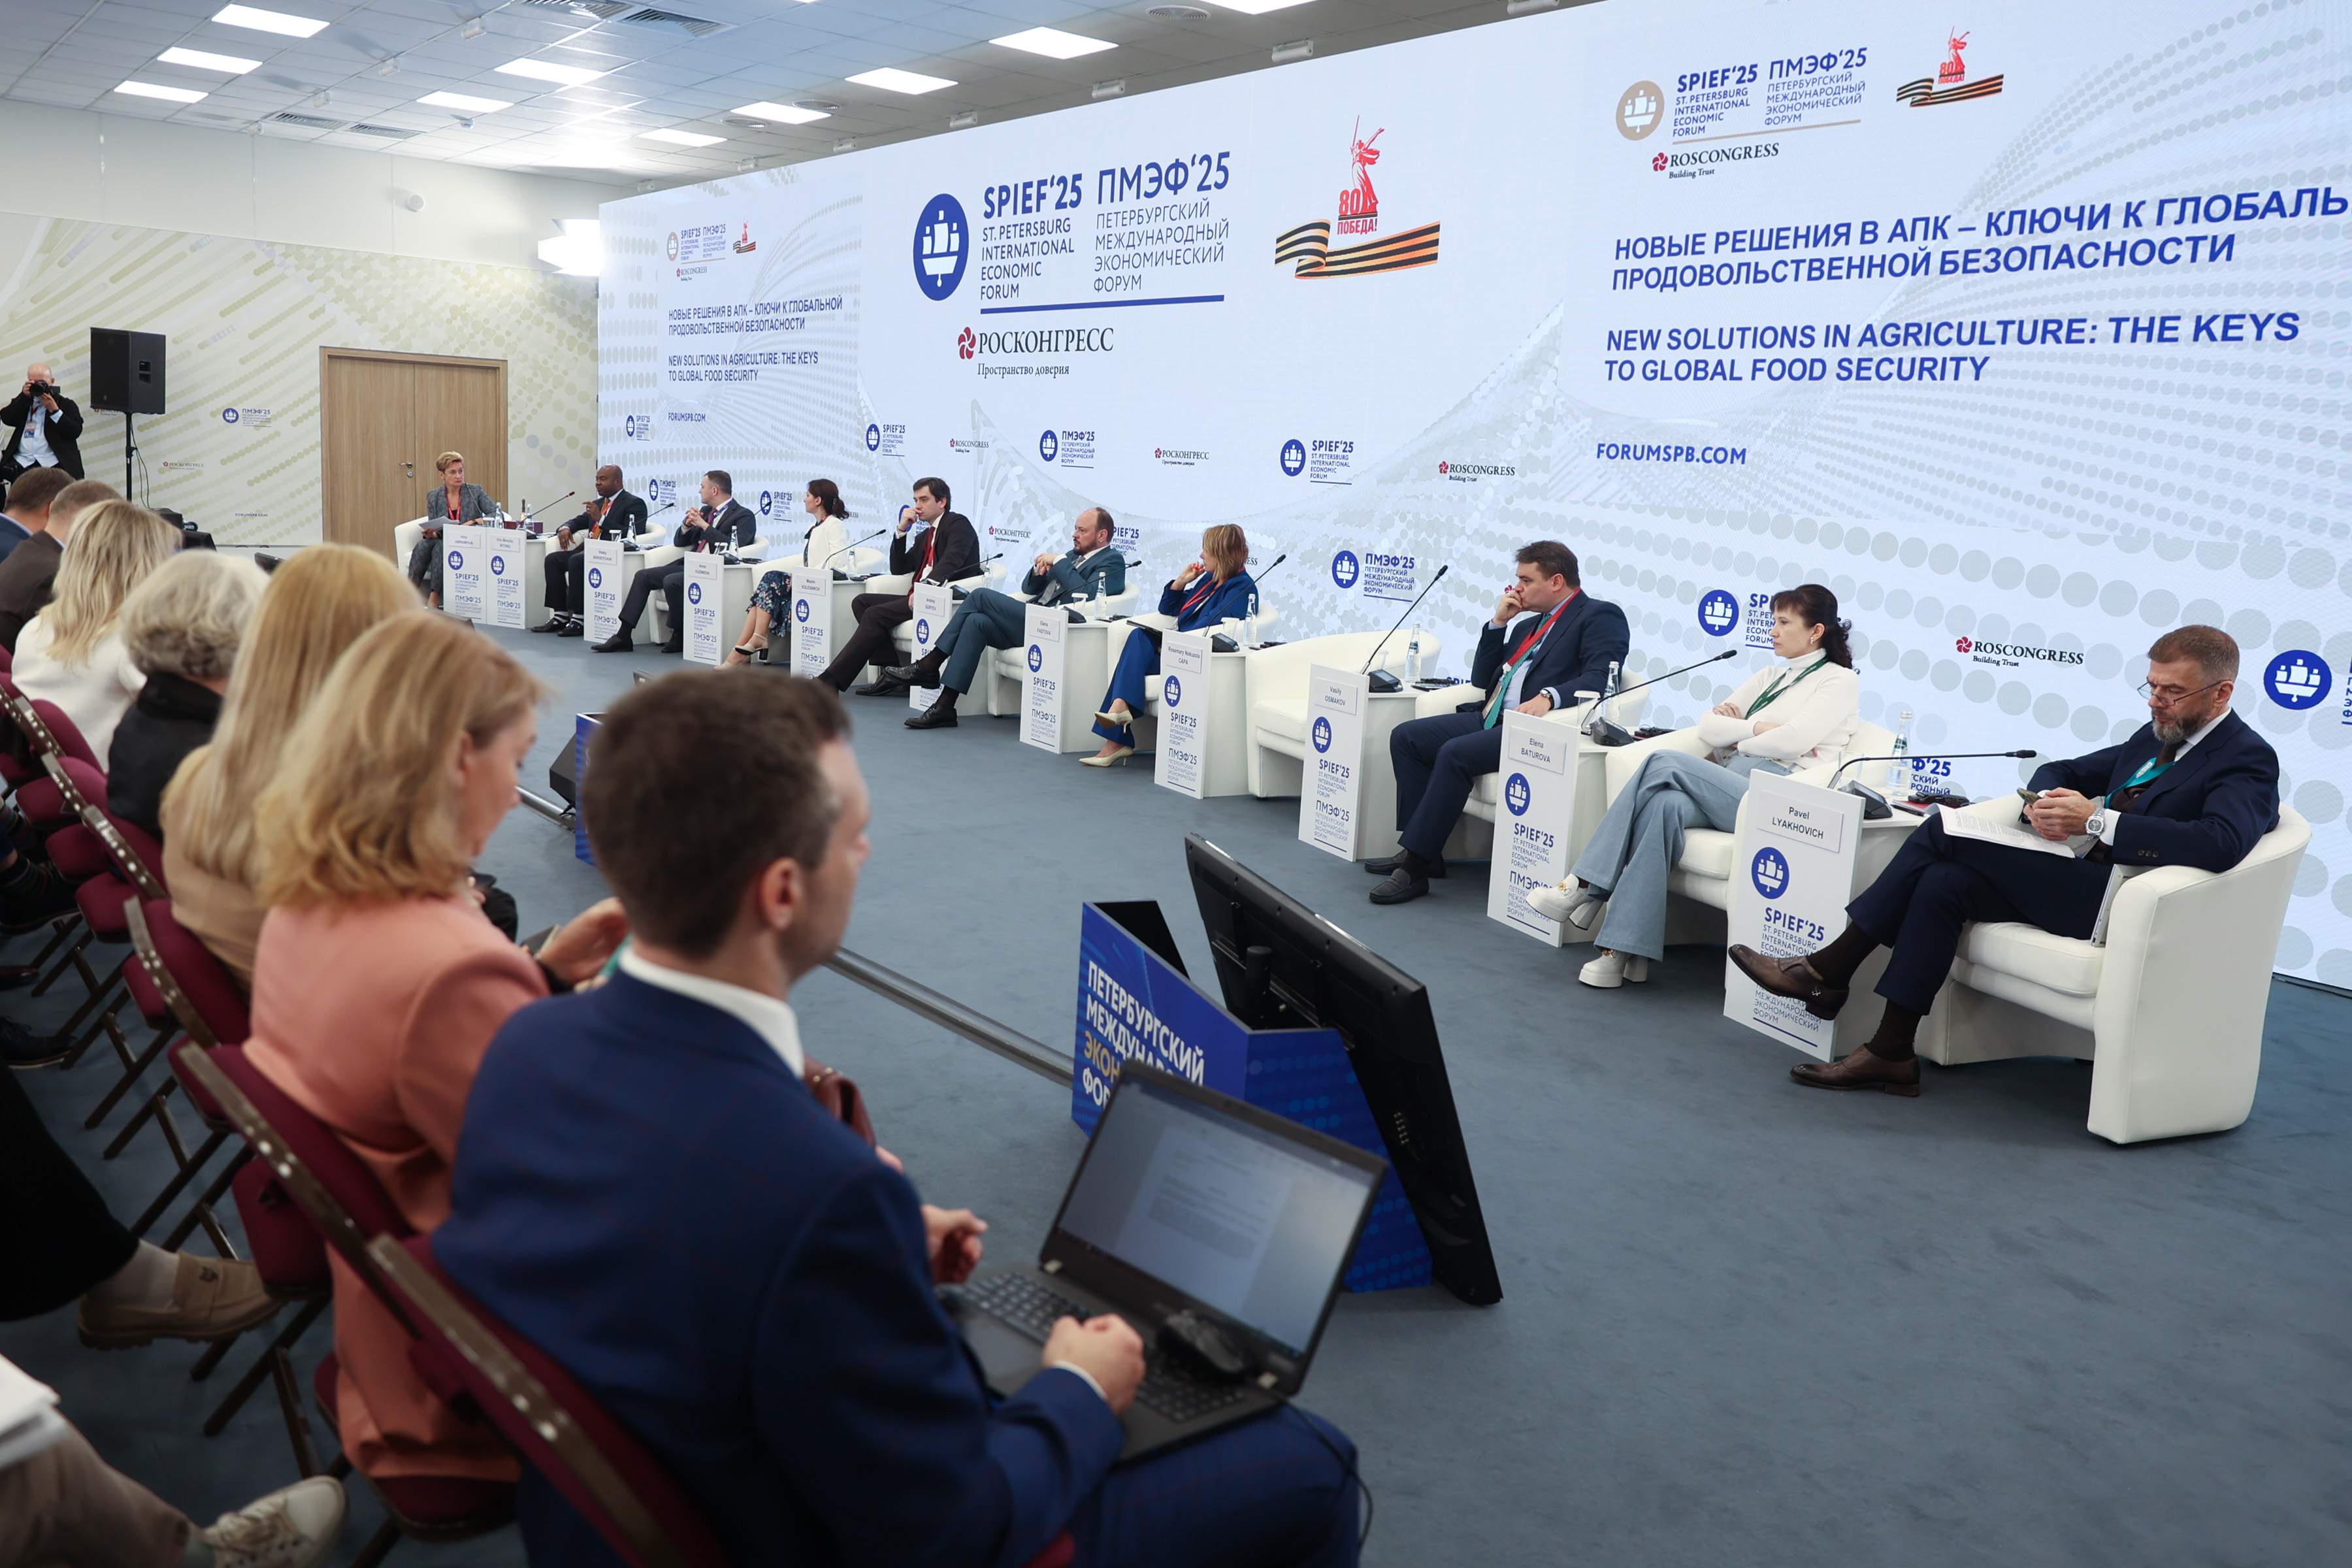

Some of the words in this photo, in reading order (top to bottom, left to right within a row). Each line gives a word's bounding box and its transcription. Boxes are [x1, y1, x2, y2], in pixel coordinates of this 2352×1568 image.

[1769, 47, 1867, 80] ПМЭФ'25
[1677, 63, 1757, 93] SPIEF'25
[1768, 71, 1852, 93] ПЕТЕРБУРГСКИЙ
[1676, 97, 1688, 105] ST.
[1690, 88, 1748, 103] PETERSBURG
[1767, 81, 1865, 104] МЕЖДУНАРОДНЫЙ
[1674, 98, 1750, 116] INTERNATIONAL
[1765, 93, 1861, 115] ЭКОНОМИЧЕСКИЙ
[1674, 112, 1724, 127] ECONOMIC
[1765, 114, 1802, 125] ФОРУМ
[1673, 125, 1705, 137] FORUM
[1670, 142, 1779, 167] ROSCONGRESS
[1098, 151, 1230, 204] ПМЭФ'25
[1669, 170, 1696, 178] Building
[983, 173, 1083, 219] SPIEF'25
[1339, 188, 1360, 216] 80
[1096, 197, 1209, 229] ПЕТЕРБУРГСКИЙ
[983, 227, 996, 242] ST.
[1000, 218, 1071, 240] PETERSBURG
[1337, 218, 1377, 235] ПОБЕДА!
[1614, 233, 1707, 260] НОВЫЕ
[1714, 222, 1852, 253] РЕШЕНИЯ
[1859, 221, 1878, 245] В
[1887, 215, 1952, 243] АПК
[1985, 203, 2112, 237] КЛЮЧИ
[2122, 200, 2146, 228] К
[2156, 186, 2352, 227] ГЛОБАЛЬ
[1096, 218, 1229, 251] МЕЖДУНАРОДНЫЙ
[982, 238, 1074, 261] INTERNATIONAL
[1094, 242, 1224, 272] ЭКОНОМИЧЕСКИЙ
[981, 261, 1041, 280] ECONOMIC
[1612, 246, 1932, 292] ПРОДОВОЛЬСТВЕННОЙ
[1938, 234, 2236, 276] БЕЗОПАСНОСТИ
[1094, 274, 1141, 293] ФОРУМ
[981, 284, 1019, 300] FORUM
[669, 308, 692, 320] НОВЫЕ
[693, 306, 725, 319] РЕШЕНИЯ
[728, 305, 732, 317] В
[734, 304, 747, 317] АПК
[755, 302, 780, 316] КЛЮЧИ
[783, 301, 787, 313] К
[789, 295, 842, 313] ГЛОБАЛЬНОЙ
[669, 318, 743, 336] ПРОДОВОЛЬСТВЕННОЙ
[745, 318, 805, 332] БЕЗОПАСНОСТИ
[1607, 329, 1661, 351] NEW
[1667, 325, 1816, 350] SOLUTIONS
[1823, 325, 1851, 348] IN
[1857, 318, 2097, 348] AGRICULTURE:
[2108, 316, 2181, 344] THE
[2192, 312, 2300, 342] KEYS
[979, 328, 1114, 353] РОСКОНГРЕСС
[669, 355, 682, 366] NEW
[683, 354, 719, 366] SOLUTIONS
[721, 354, 727, 365] IN
[728, 353, 780, 365] AGRICULTURE:
[782, 352, 796, 364] THE
[798, 351, 818, 364] KEYS
[669, 370, 676, 381] TO
[678, 370, 703, 381] GLOBAL
[705, 370, 723, 381] FOOD
[724, 370, 758, 381] SECURITY
[978, 363, 1033, 378] Пространство
[1035, 366, 1070, 378] доверия
[1604, 359, 1635, 381] TO
[1642, 359, 1743, 381] GLOBAL
[1750, 358, 1827, 381] FOOD
[1835, 357, 1990, 382] SECURITY
[668, 412, 706, 421] FORUMSPB.COM
[883, 424, 905, 433] SPIEF'25
[1062, 431, 1095, 442] ПМЭФ'25
[955, 440, 989, 448] ROSCONGRESS
[1312, 440, 1354, 453] SPIEF'25
[1162, 450, 1209, 460] РОСКОНГРЕСС
[1597, 443, 1746, 465] FORUMSPB.COM
[1449, 464, 1515, 476] ROSCONGRESS
[774, 492, 792, 500] SPIEF'25
[994, 528, 1030, 538] РОСКОНГРЕСС
[1113, 527, 1139, 538] PIEF'25
[1365, 553, 1414, 569] ПМЭФ'25
[1364, 573, 1414, 583] МЕЖДУНАРОДНЫЙ
[1365, 566, 1407, 576] ПЕТЕРБУРГСКИЙ
[1364, 580, 1412, 591] ЭКОНОМИЧЕСКИЙ
[595, 592, 615, 600] SPIEF'25
[497, 600, 521, 609] ПМЭФ'25
[694, 608, 715, 617] SPIEF'25
[694, 633, 717, 643] ПМЭФ'25
[802, 627, 823, 636] SPIEF'25
[801, 653, 825, 664] ПМЭФ'25
[1168, 646, 1184, 656] Rosemary
[1185, 650, 1200, 659] Nokuzola
[1972, 655, 2000, 666] Building
[1974, 642, 2084, 664] ROSCONGRESS
[1034, 677, 1055, 690] SPIEF'25
[1330, 685, 1342, 695] Vasily
[1325, 695, 1346, 706] OSMAKOV
[1032, 709, 1056, 723] ПМЭФ'25
[1171, 712, 1196, 728] SPIEF'25
[1529, 738, 1544, 749] Elena
[1169, 748, 1197, 764] ПМЭФ'25
[1521, 747, 1550, 763] BATUROVA
[1319, 759, 1350, 778] SPIEF'25
[1316, 800, 1349, 821] ПМЭФ'25
[1789, 806, 1810, 820] Pavel
[1514, 823, 1554, 847] SPIEF'25
[1772, 817, 1824, 840] LYAKHOVICH
[1512, 844, 1550, 864] INTERNATIONAL
[1520, 840, 1548, 855] PETERSBURG
[1511, 859, 1527, 870] FORUM
[1512, 852, 1537, 866] ECONOMIC
[1507, 907, 1524, 919] ФОРУМ
[1765, 907, 1825, 941] SPIEF'25
[1763, 924, 1772, 934] ST.
[1773, 928, 1816, 950] PETERSBURG
[1088, 960, 1205, 1087] ПЕТЕРБУРГСКИЙ
[1754, 999, 1819, 1032] ЭКОНОМИЧЕСКИЙ
[1754, 1008, 1778, 1023] ФОРУМ
